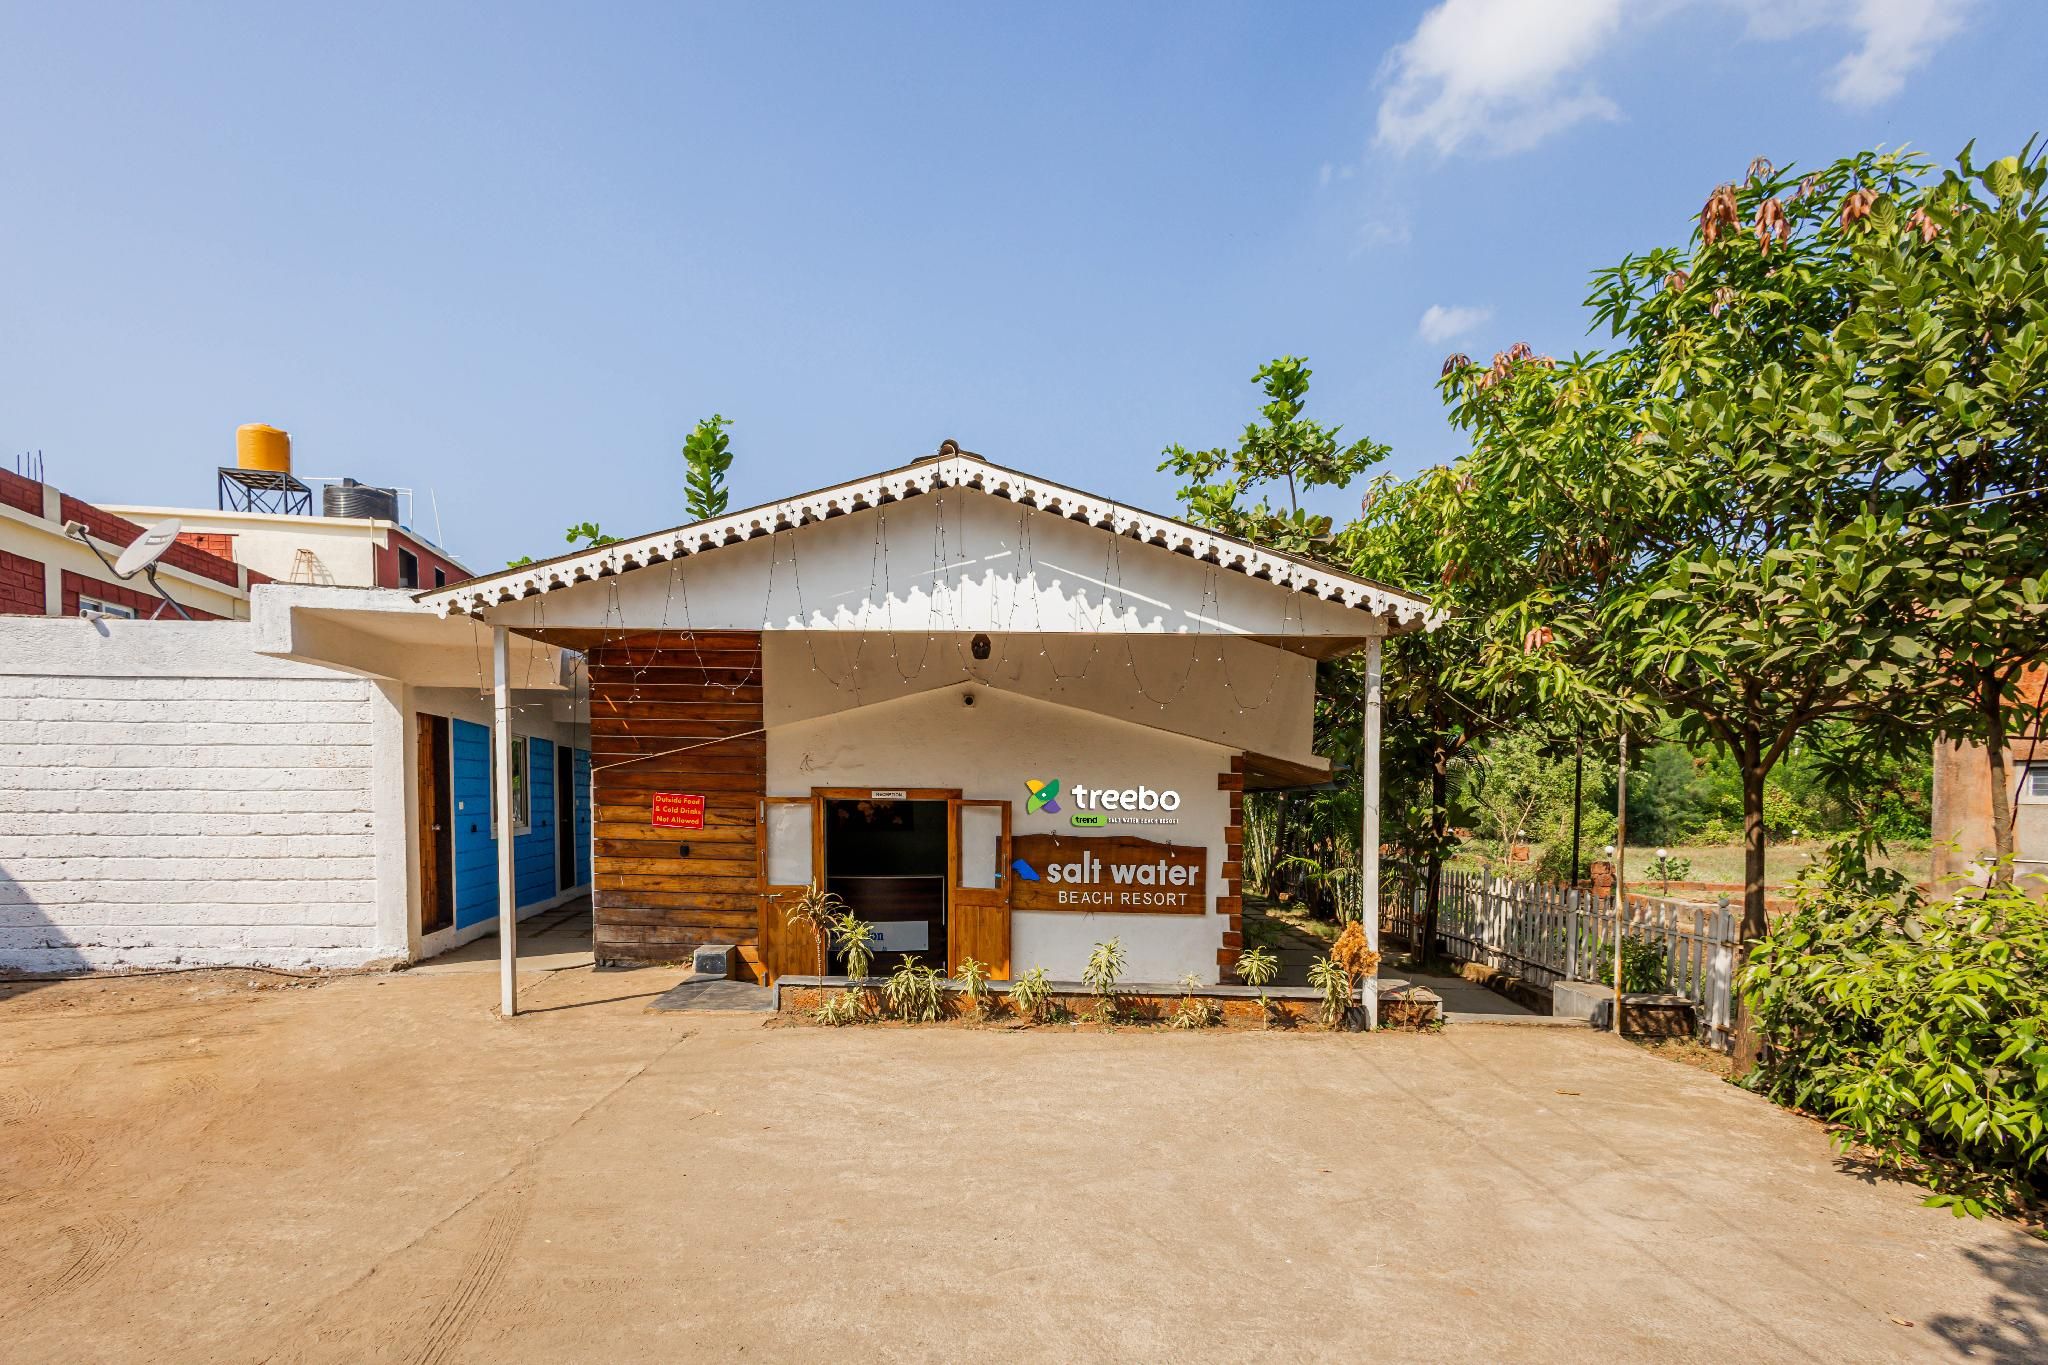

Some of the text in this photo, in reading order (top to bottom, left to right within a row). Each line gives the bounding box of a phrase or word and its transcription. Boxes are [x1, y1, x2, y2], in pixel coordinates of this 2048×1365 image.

[655, 795, 701, 805] Outside Food
[1071, 784, 1181, 811] treebo
[662, 805, 679, 814] Cold
[680, 807, 702, 815] Drinks
[671, 816, 700, 825] Allowed
[1075, 816, 1098, 824] trend
[1046, 850, 1200, 886] salt water
[1058, 890, 1188, 906] BEACH RESORT
